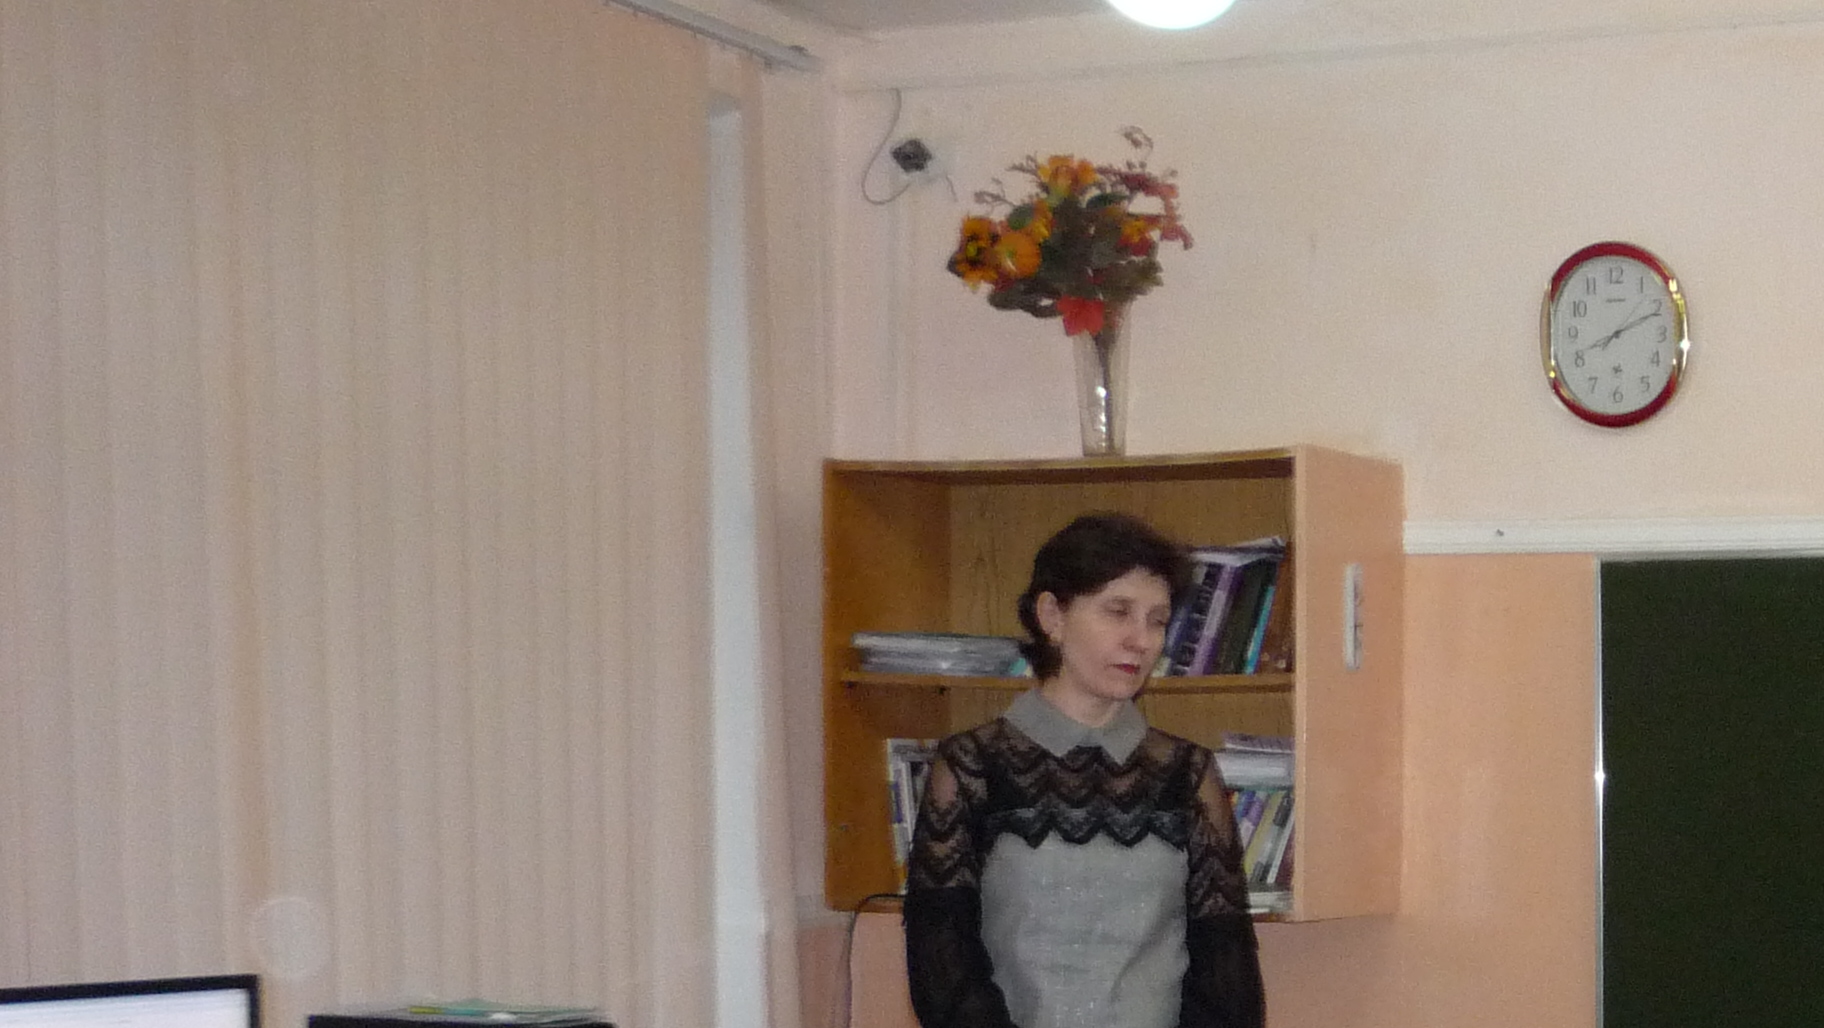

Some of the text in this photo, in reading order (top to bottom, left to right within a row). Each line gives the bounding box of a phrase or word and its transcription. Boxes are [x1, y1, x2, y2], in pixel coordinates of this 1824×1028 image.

[1609, 266, 1624, 285] 12
[1586, 276, 1597, 295] 11
[1572, 300, 1588, 318] 10
[1650, 299, 1663, 317] 2
[1568, 325, 1579, 343] 9
[1657, 326, 1668, 344] 3
[1574, 350, 1586, 368] 8
[1651, 350, 1661, 368] 4
[1588, 376, 1599, 394] 7
[1640, 376, 1651, 393] 5
[1613, 385, 1624, 403] 6
